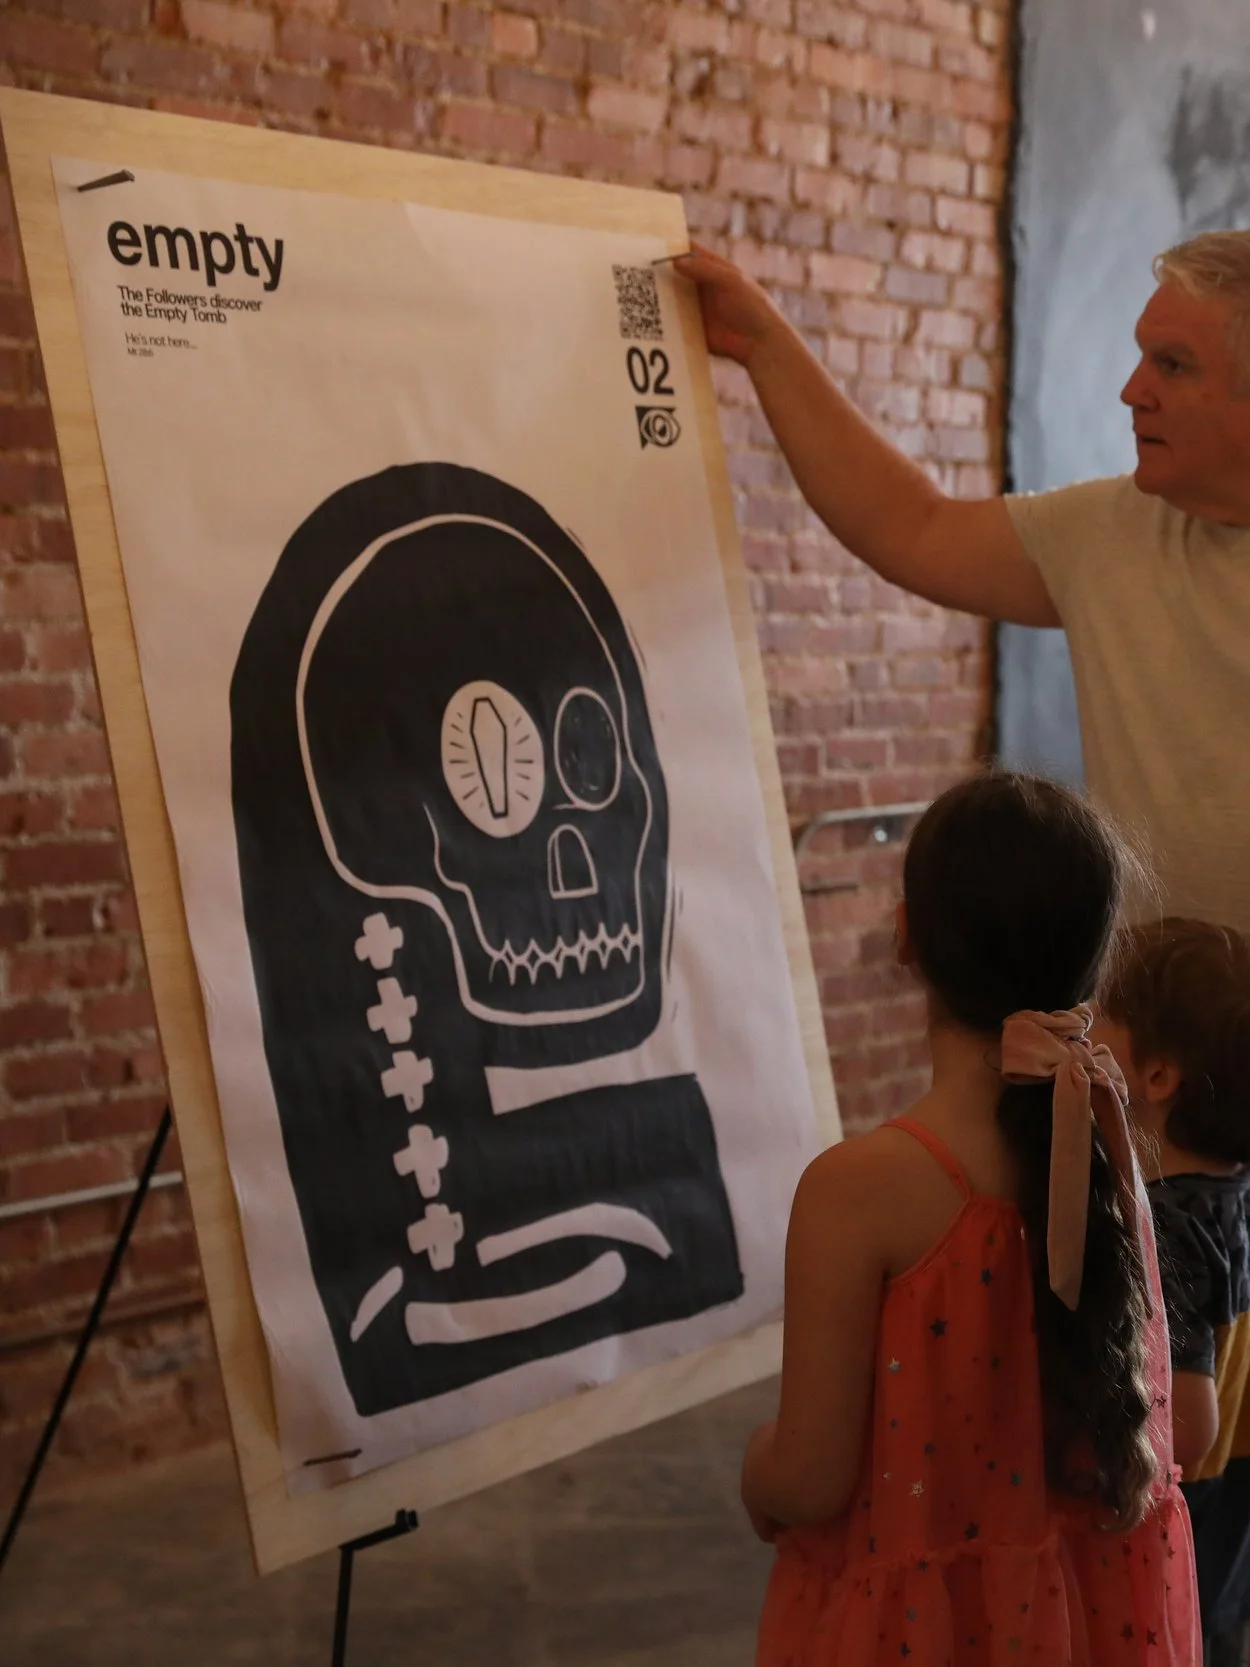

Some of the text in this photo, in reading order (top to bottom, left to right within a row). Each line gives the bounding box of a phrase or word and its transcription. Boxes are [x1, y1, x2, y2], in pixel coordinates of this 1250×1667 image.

[107, 221, 284, 292] empty
[117, 285, 263, 311] The Followers discover
[121, 303, 227, 324] the Empty Tomb
[125, 332, 148, 346] He's
[149, 335, 167, 347] not
[626, 346, 675, 395] 02
